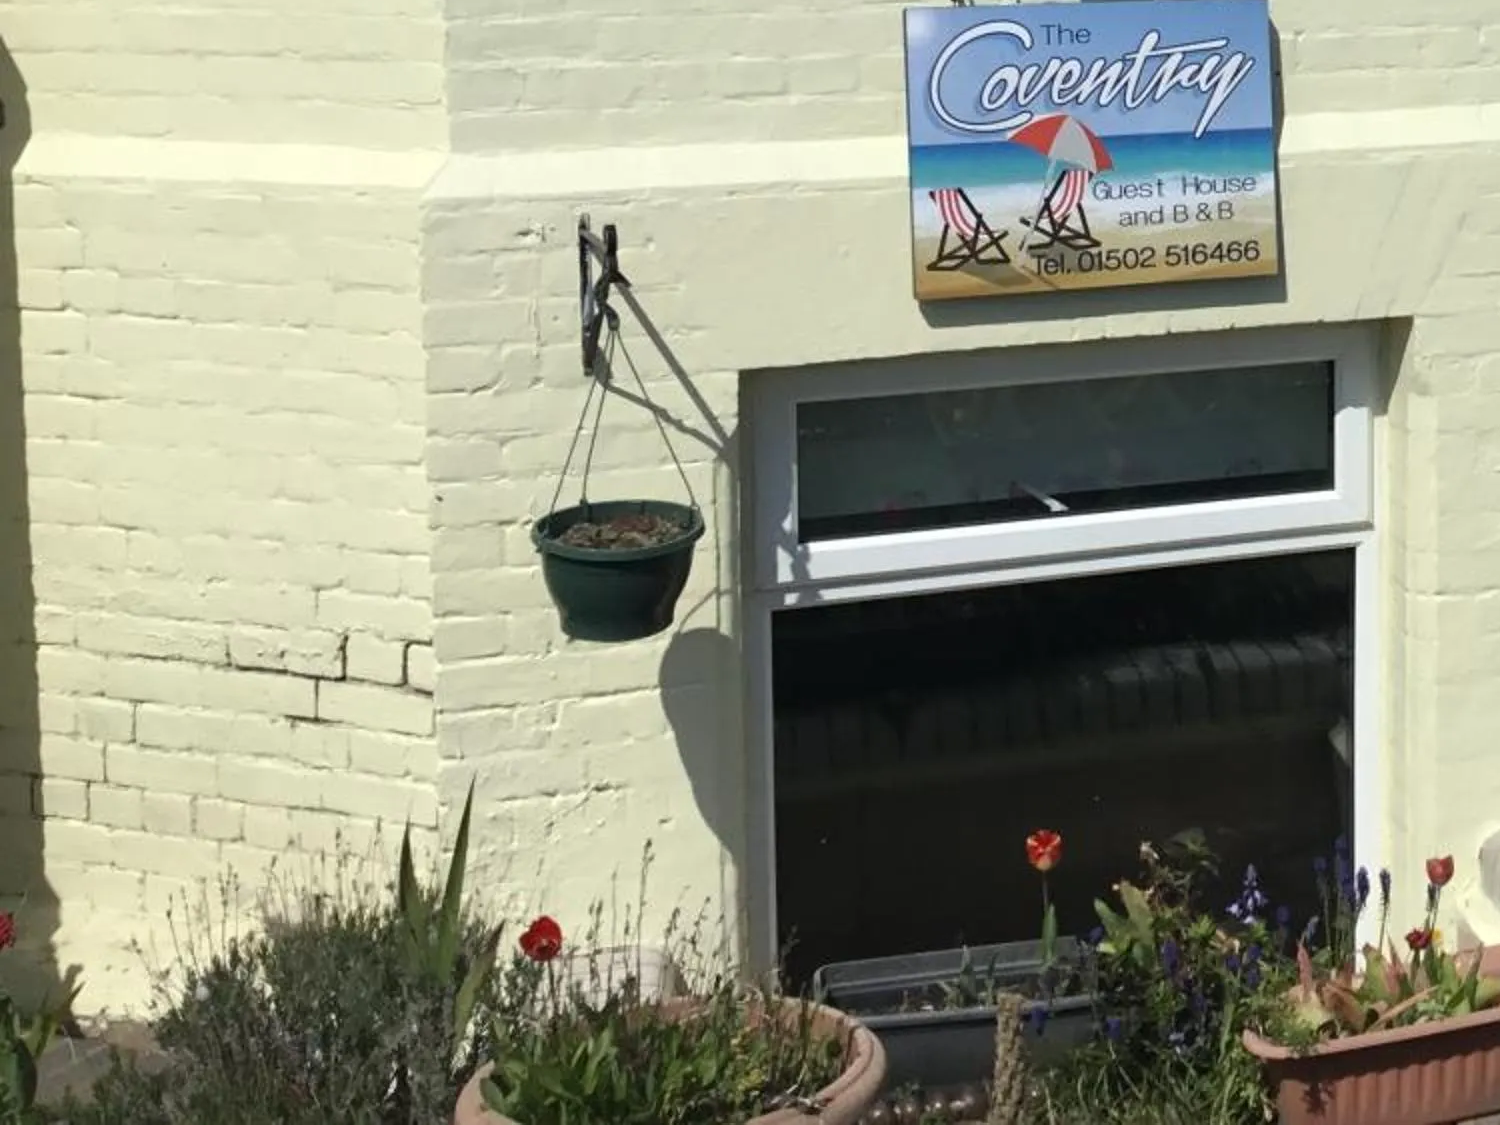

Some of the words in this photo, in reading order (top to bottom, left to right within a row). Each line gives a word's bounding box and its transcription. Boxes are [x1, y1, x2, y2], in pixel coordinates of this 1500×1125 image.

[1040, 24, 1091, 46] The
[930, 19, 1255, 138] Coventry
[1092, 179, 1165, 200] Guest
[1182, 176, 1257, 195] House
[1119, 206, 1164, 227] and
[1174, 204, 1189, 223] B
[1217, 202, 1234, 220] B
[1034, 254, 1071, 276] Tel.
[1078, 247, 1157, 272] 01502
[1164, 240, 1260, 266] 516466
